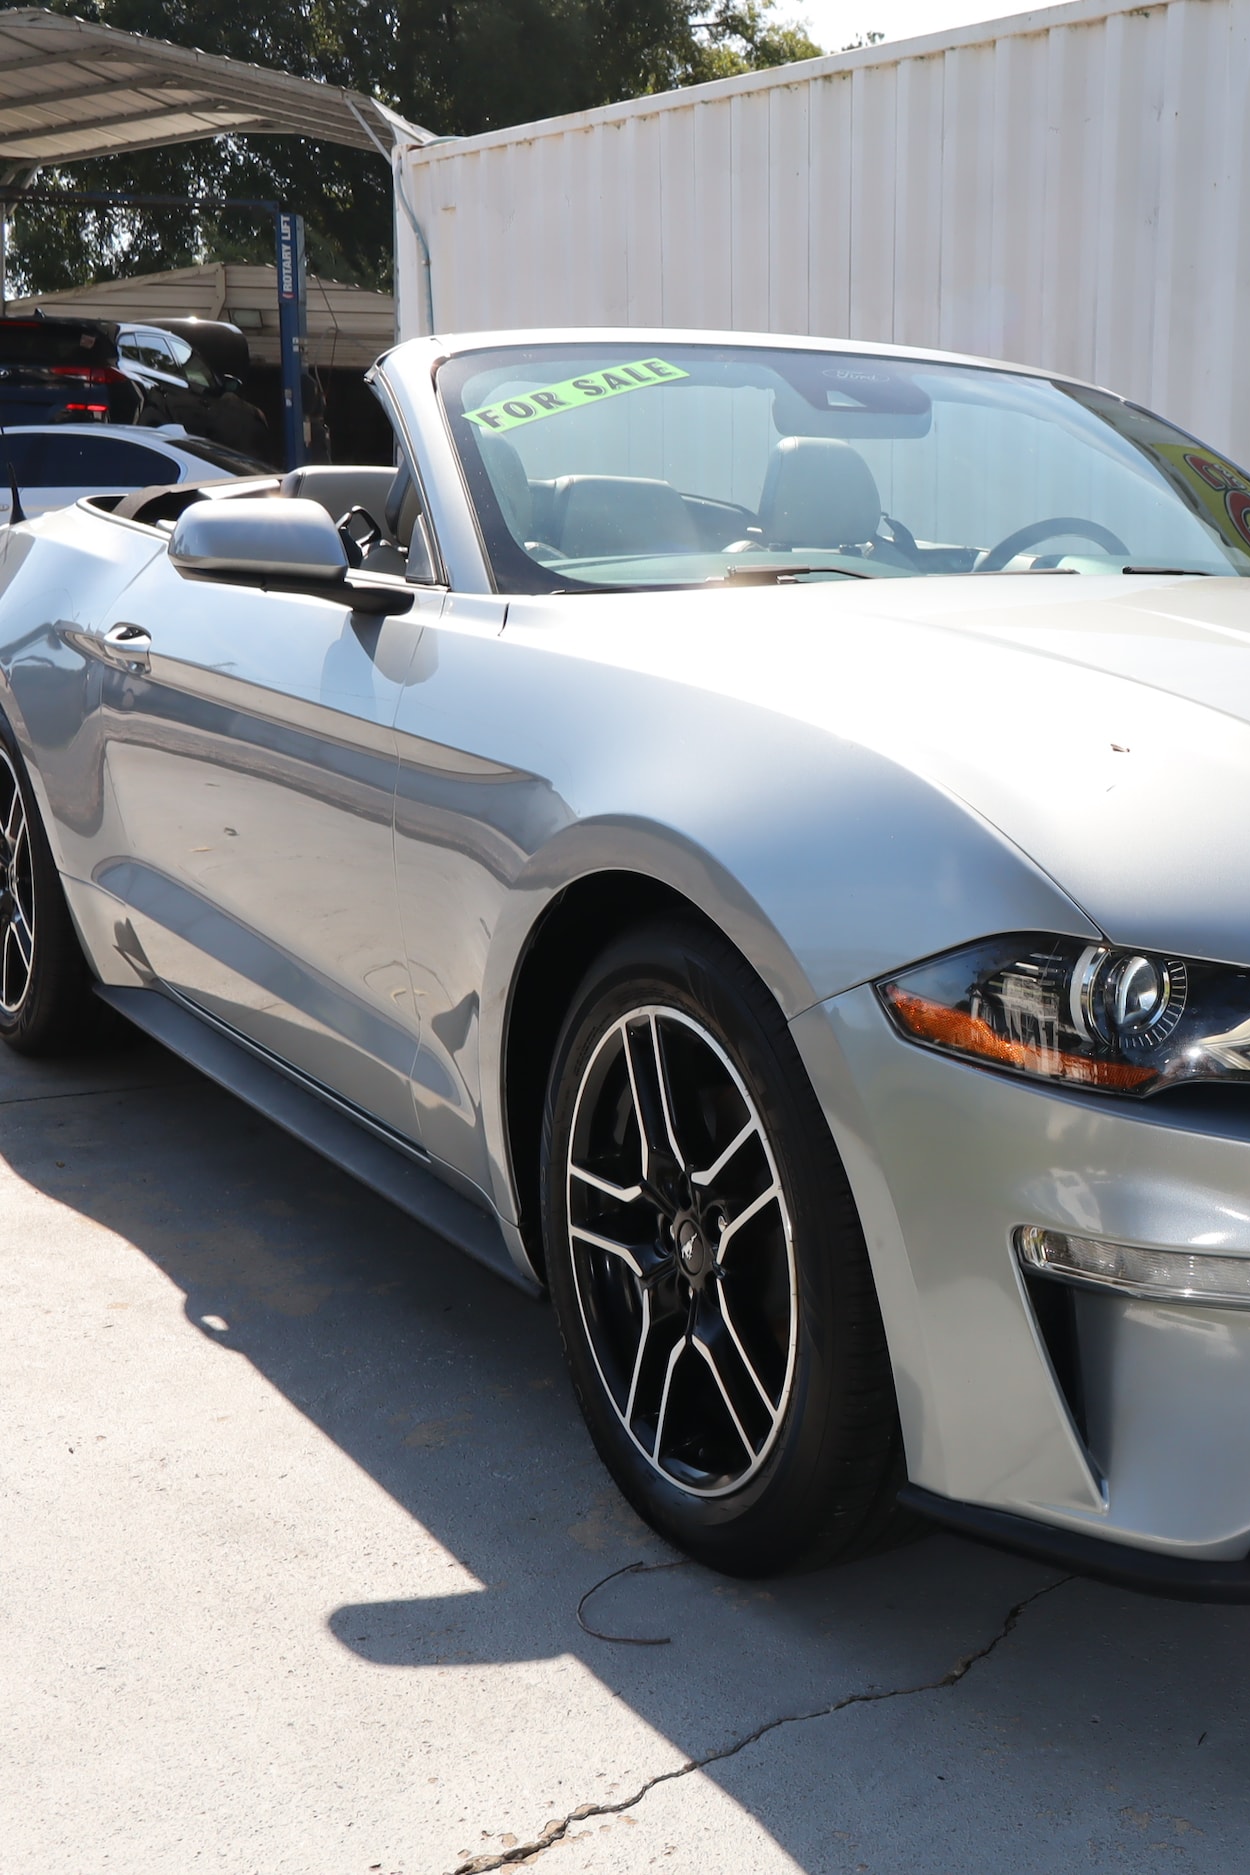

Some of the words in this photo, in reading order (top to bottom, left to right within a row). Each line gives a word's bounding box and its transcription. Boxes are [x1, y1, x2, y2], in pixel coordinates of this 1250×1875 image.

[280, 214, 291, 241] LIFT
[281, 243, 292, 292] ROTARY
[476, 391, 565, 428] FOR
[572, 361, 673, 396] SALE
